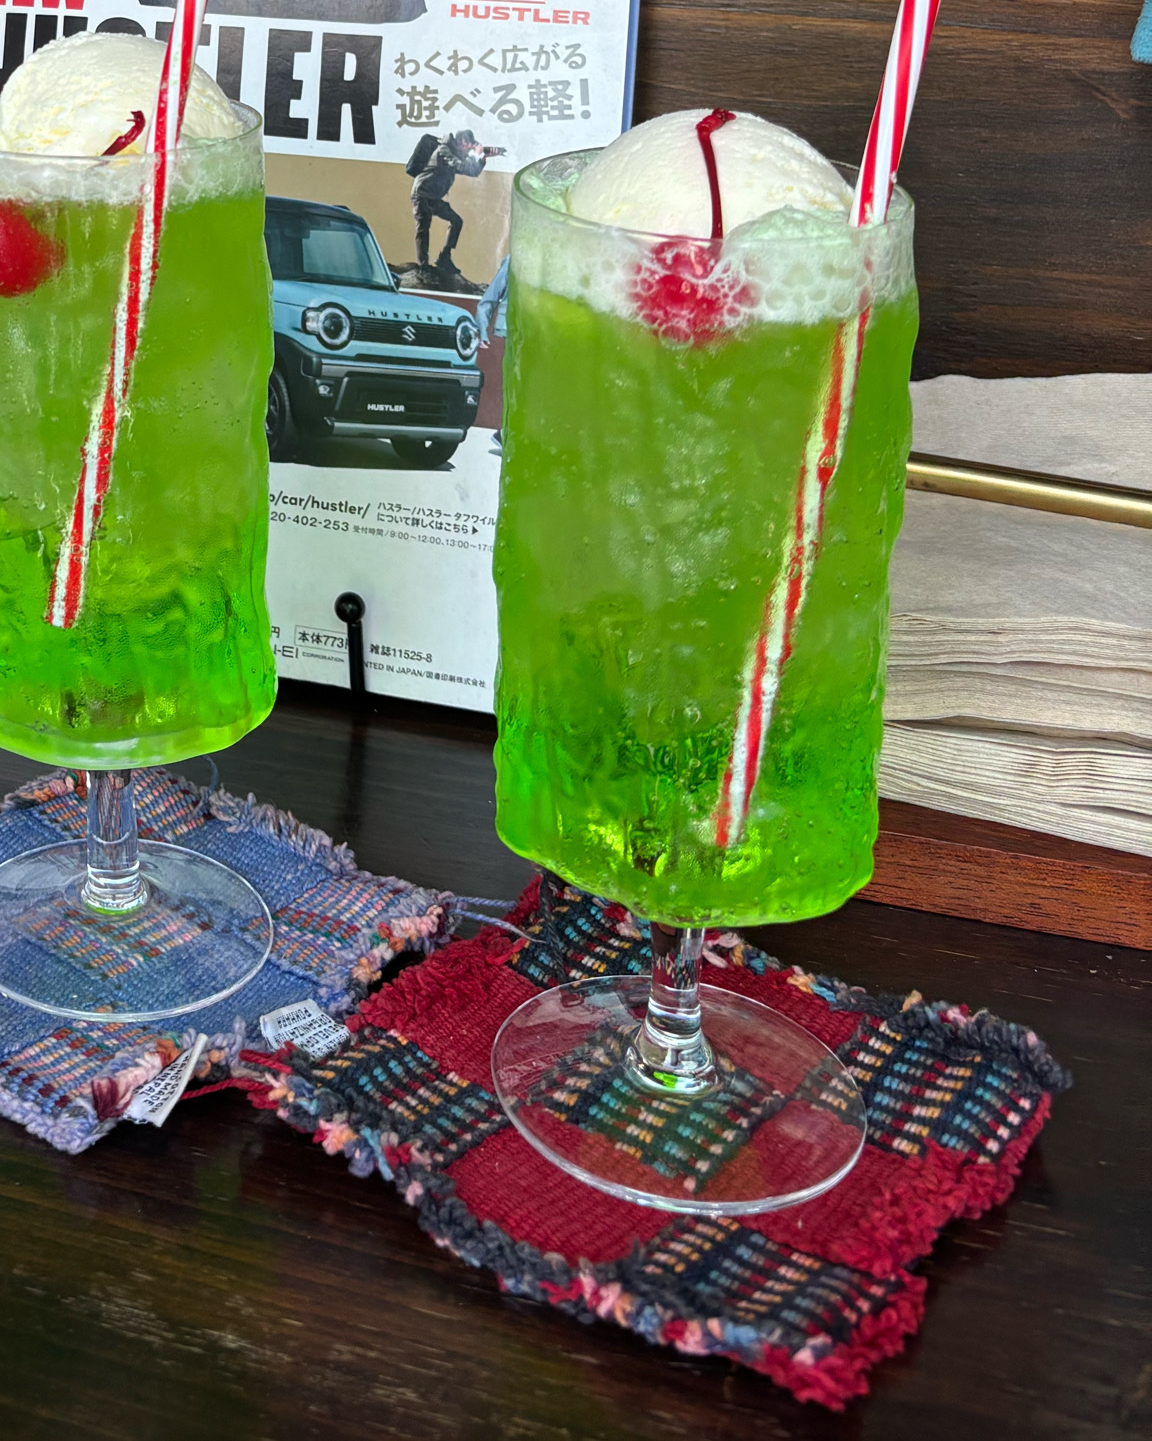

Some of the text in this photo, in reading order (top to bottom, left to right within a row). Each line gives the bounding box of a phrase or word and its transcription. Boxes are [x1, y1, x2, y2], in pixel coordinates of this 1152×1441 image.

[450, 4, 591, 25] HUSTLER
[394, 42, 587, 78] わくわく広がる
[395, 78, 592, 128] 遊べる軽!
[368, 309, 443, 323] HUSTLER
[367, 403, 405, 413] HUSTLER
[298, 630, 348, 649] 本体773
[369, 643, 433, 663] 雑誌11525-8
[139, 1071, 170, 1096] NEPAL
[144, 1082, 173, 1106] MADE
